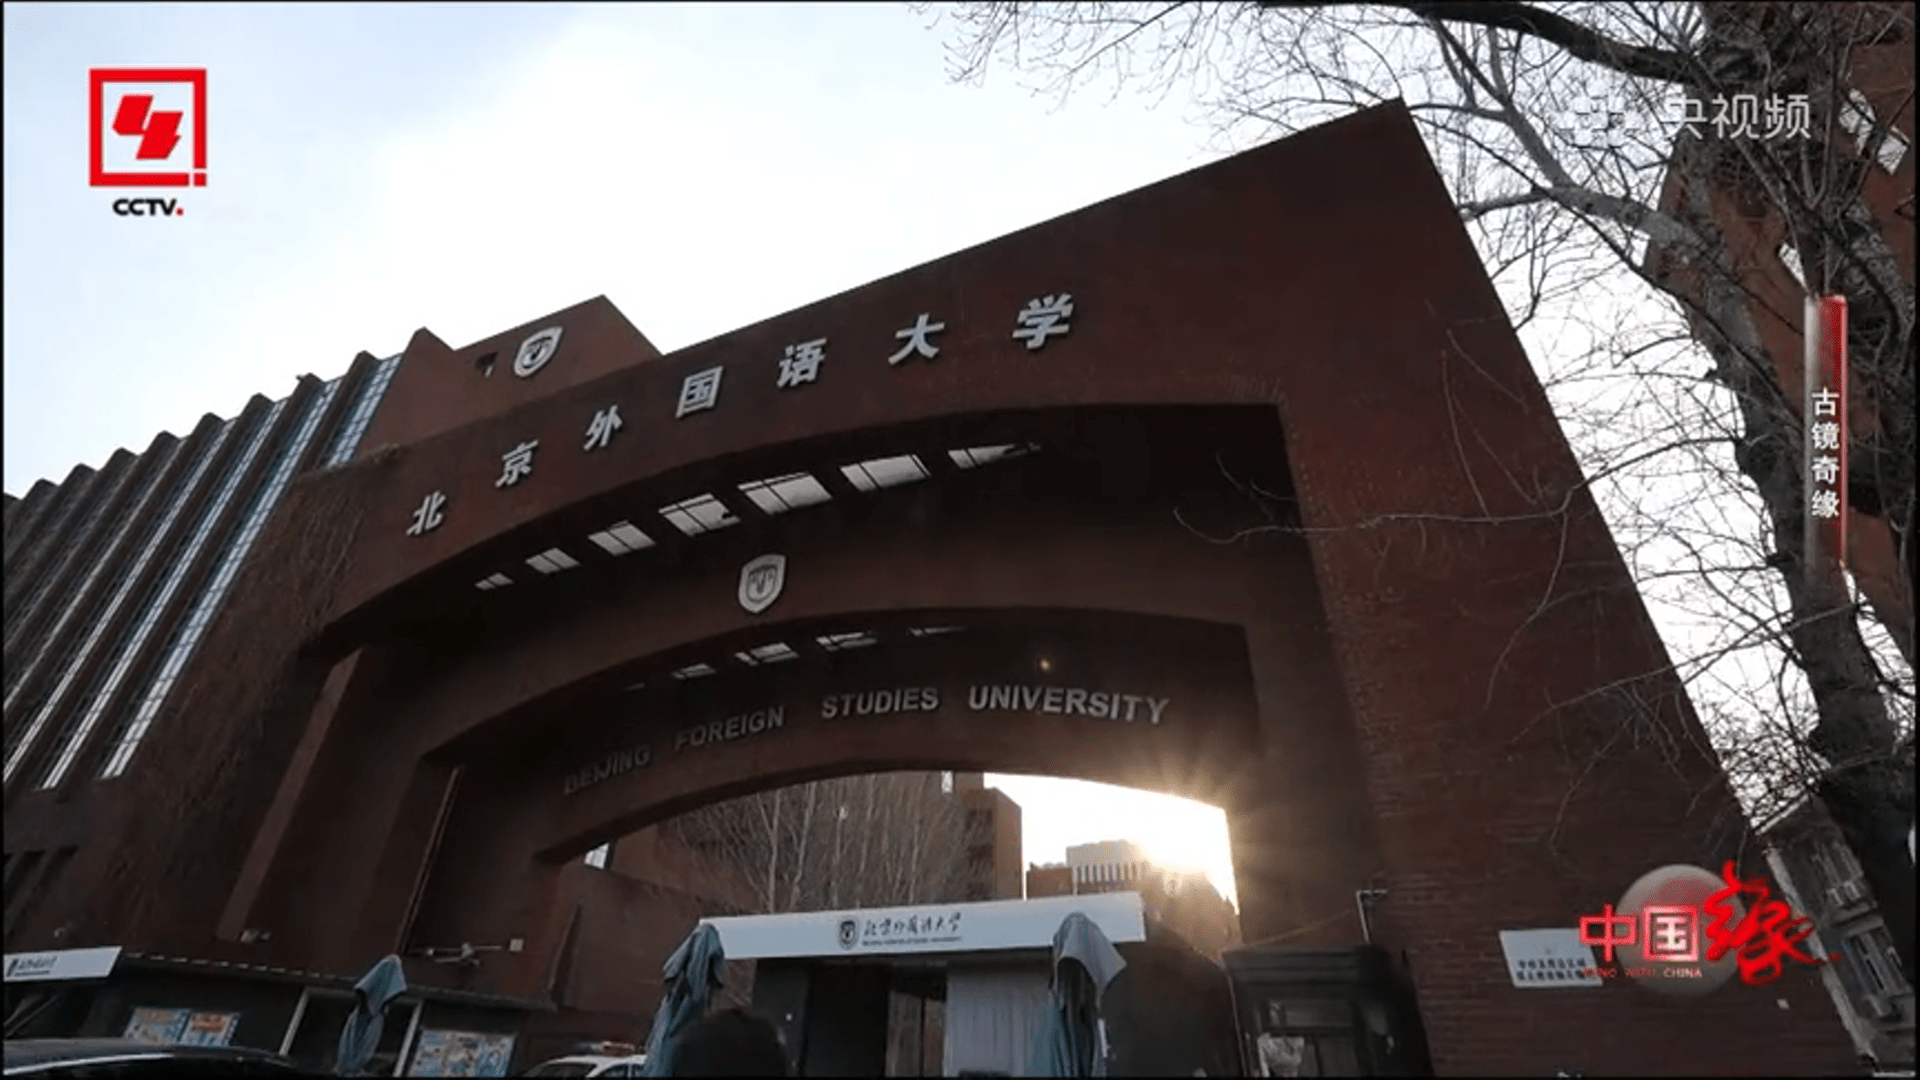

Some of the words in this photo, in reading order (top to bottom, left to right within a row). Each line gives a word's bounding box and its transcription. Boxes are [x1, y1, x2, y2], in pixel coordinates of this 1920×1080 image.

[405, 293, 1074, 537] 北京外国语大学
[563, 744, 651, 796] BEIJING
[674, 704, 786, 752] FOREIGN
[820, 686, 939, 719] STUDIES
[968, 684, 1170, 725] UNIVERSITY
